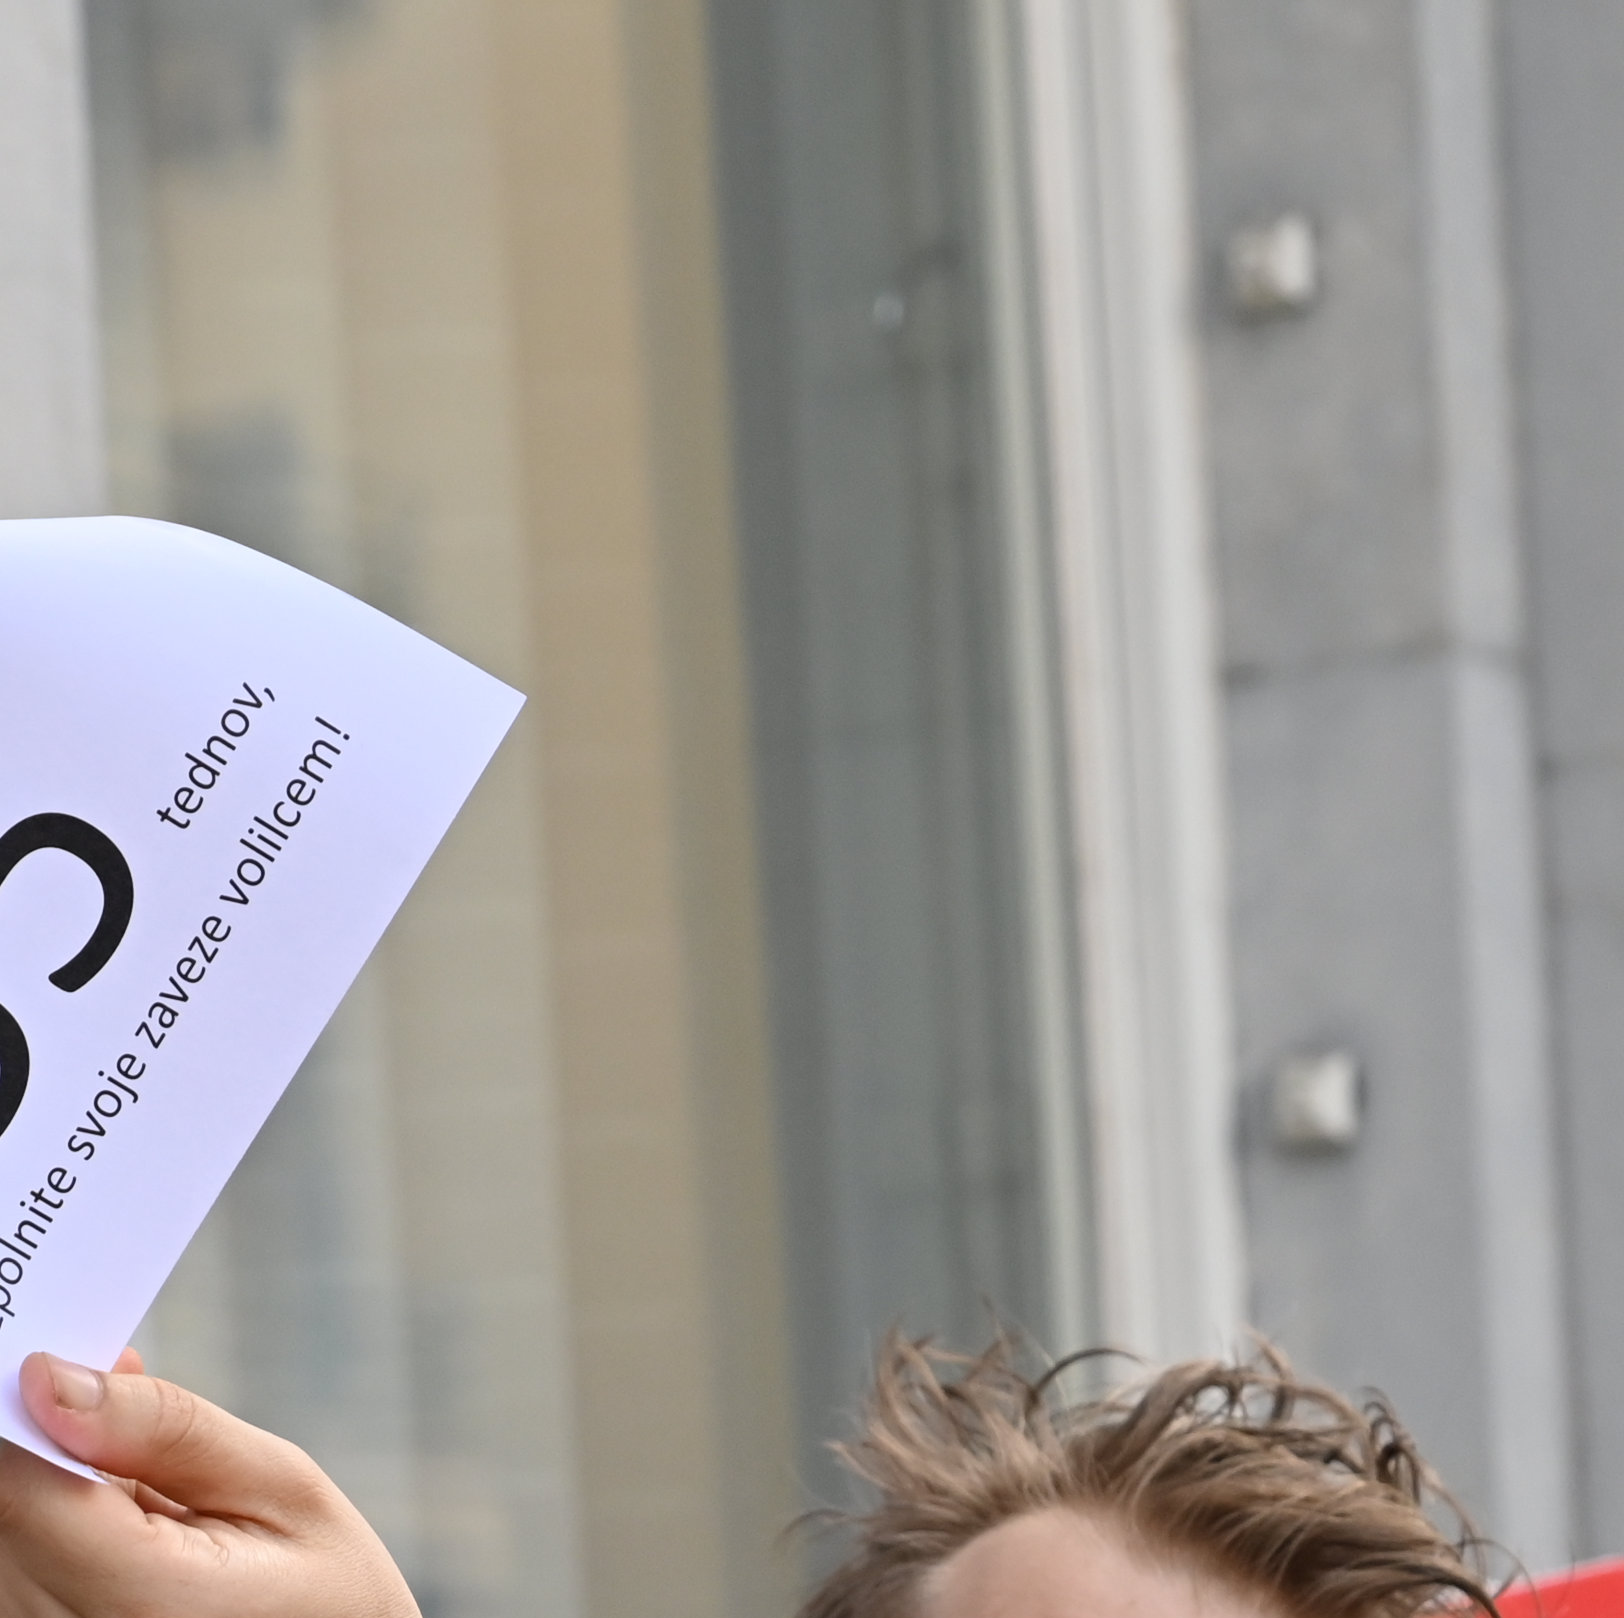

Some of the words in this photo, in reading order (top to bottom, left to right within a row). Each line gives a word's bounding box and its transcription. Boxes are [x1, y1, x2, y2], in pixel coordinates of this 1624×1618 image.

[155, 680, 276, 832] tednov,
[67, 1049, 147, 1162] svoje
[133, 914, 233, 1051] zaveze
[219, 714, 352, 907] volilcem!
